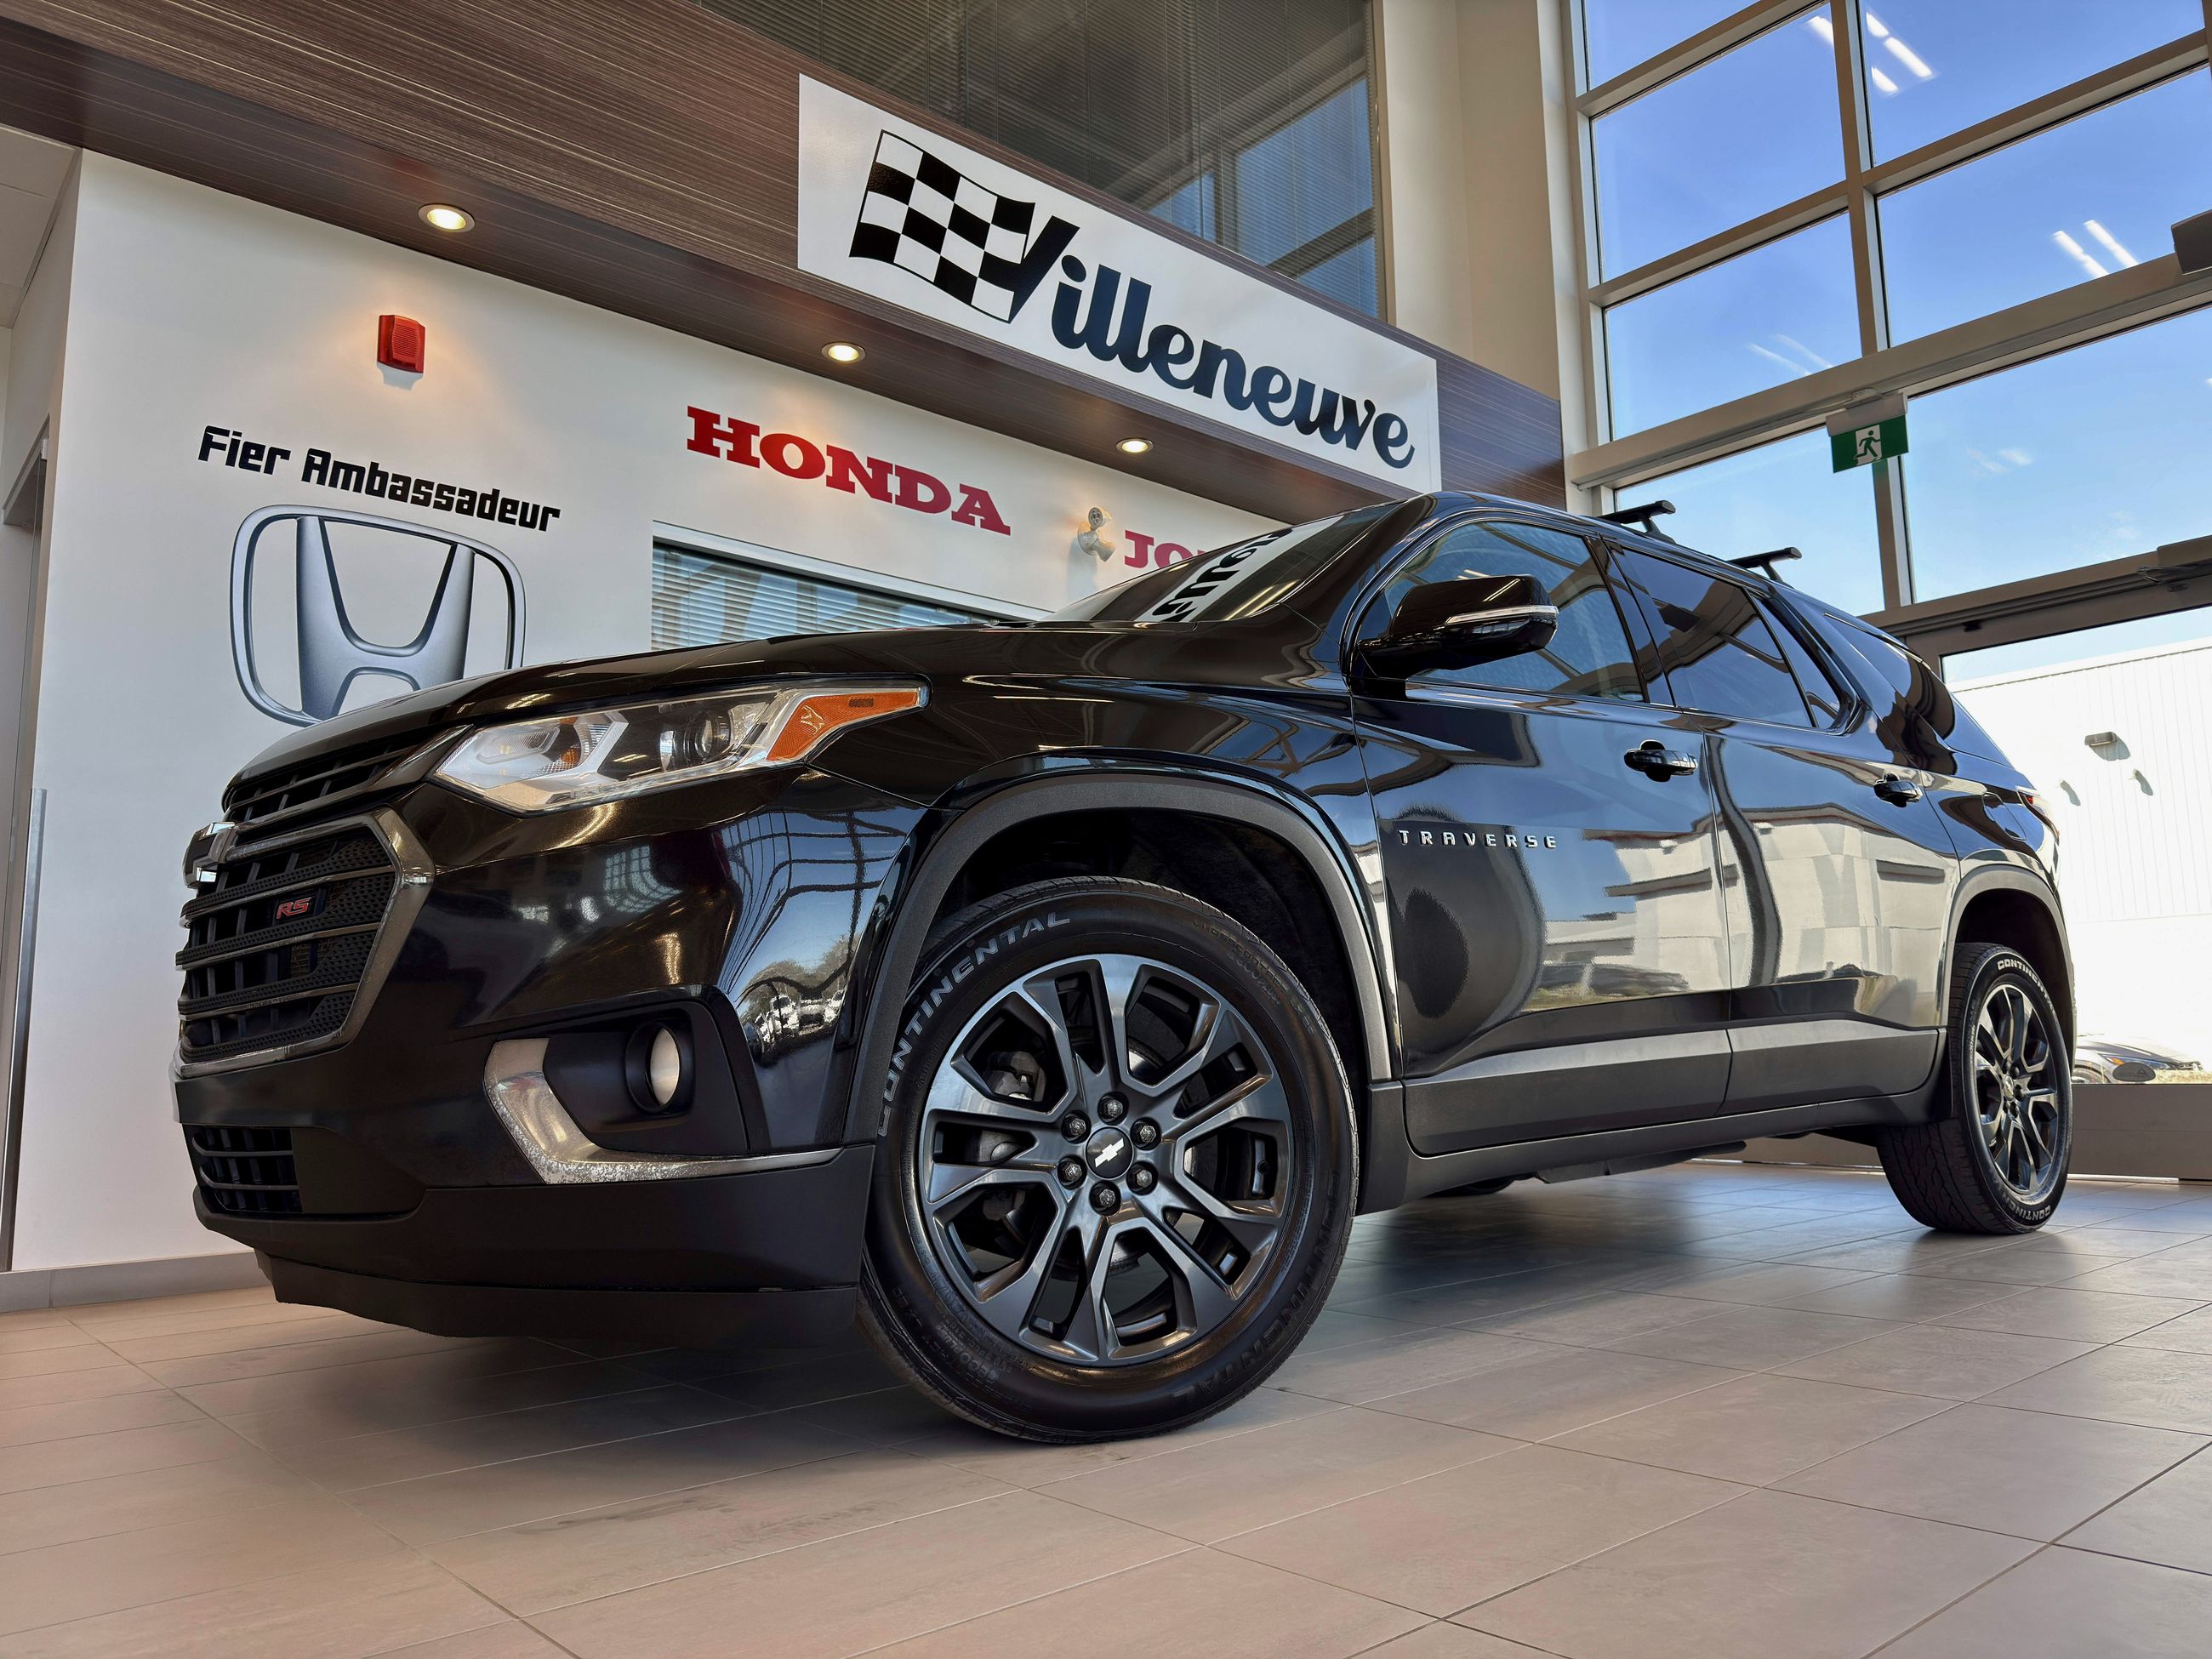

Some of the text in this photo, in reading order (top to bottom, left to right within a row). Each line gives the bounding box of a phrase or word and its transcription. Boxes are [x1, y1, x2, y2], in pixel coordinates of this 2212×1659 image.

[978, 214, 1415, 470] Villeneuve
[198, 425, 561, 532] Fier Ambassadeur
[687, 406, 1011, 535] HONDA
[1124, 529, 1209, 569] JO
[1398, 830, 1557, 849] TRAVERSE
[276, 897, 312, 920] RS
[878, 911, 1070, 1137] CONTINENTAL
